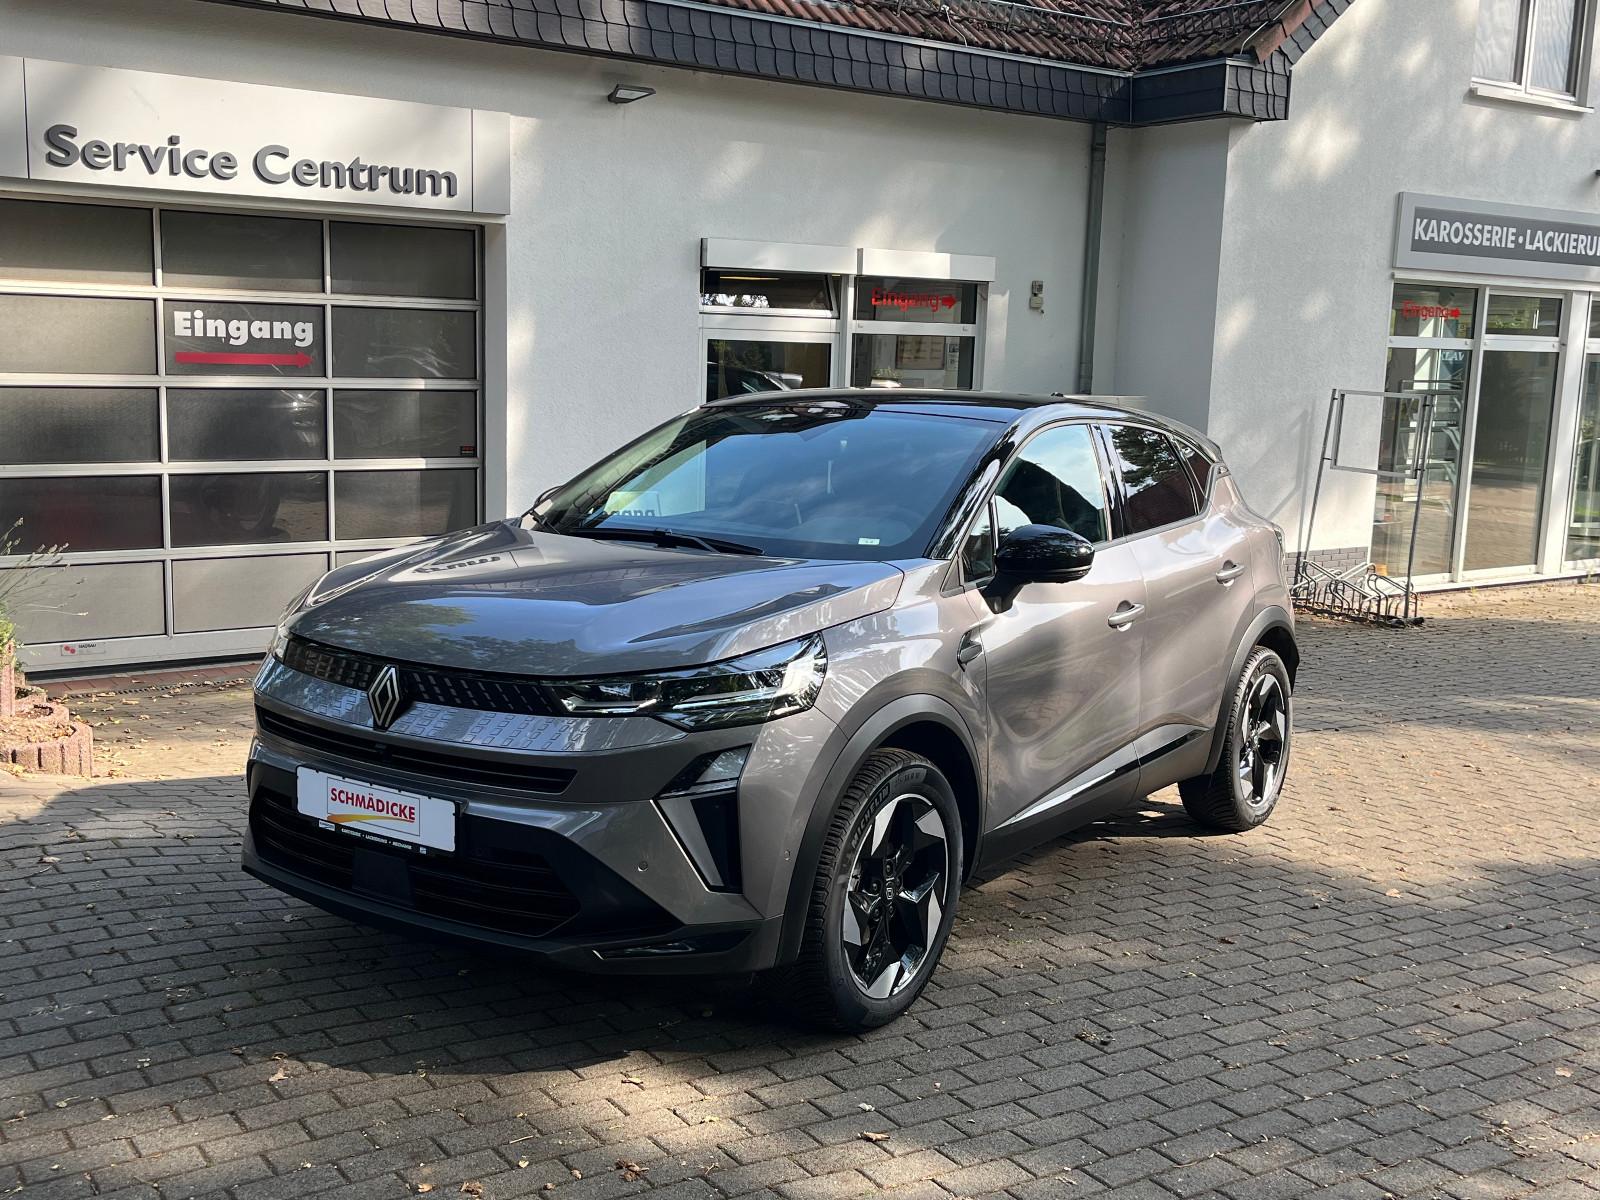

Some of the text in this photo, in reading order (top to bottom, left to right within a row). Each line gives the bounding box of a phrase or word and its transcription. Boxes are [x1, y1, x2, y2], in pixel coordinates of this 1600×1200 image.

[44, 124, 458, 198] Service Centrum
[1414, 218, 1600, 257] KAROSSERIE LACKIERU
[871, 287, 939, 312] Eingang
[174, 310, 314, 347] Eingang
[330, 787, 416, 821] SCHMÄDICKE
[851, 785, 890, 849] MICHELIN
